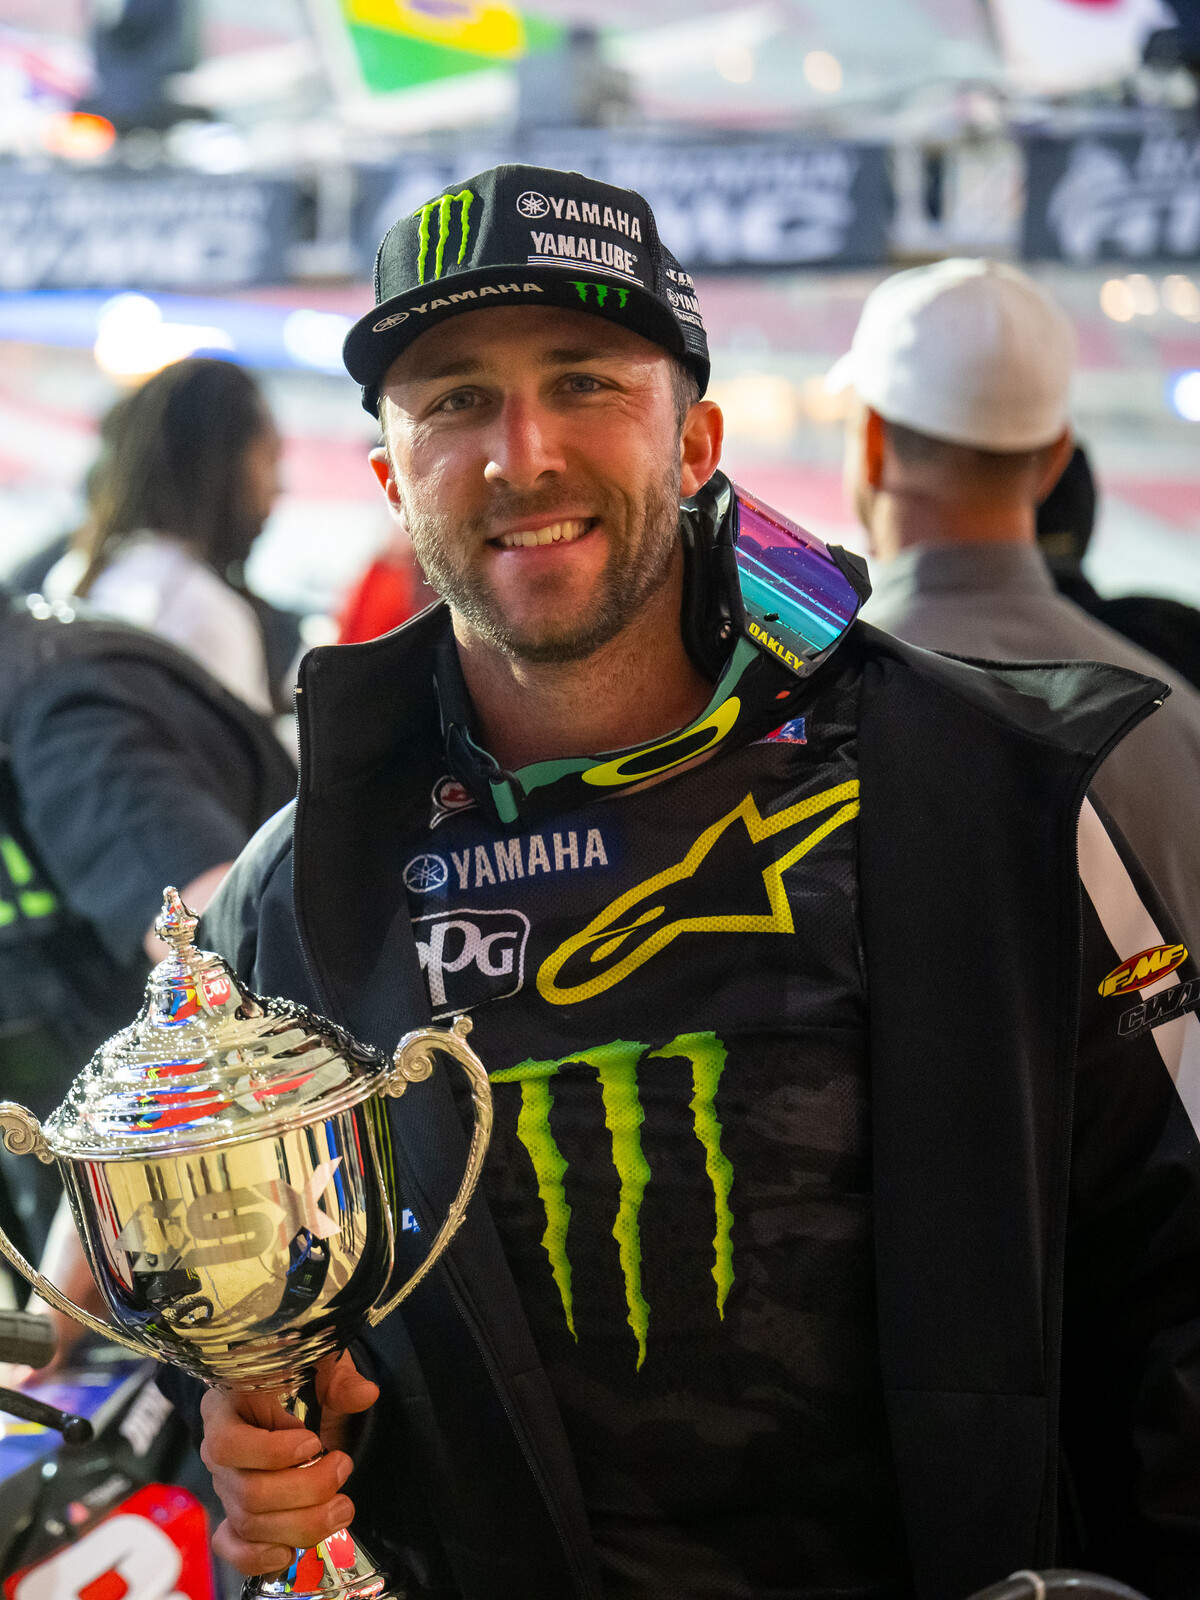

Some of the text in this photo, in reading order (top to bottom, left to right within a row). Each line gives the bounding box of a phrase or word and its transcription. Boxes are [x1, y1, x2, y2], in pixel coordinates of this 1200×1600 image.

[549, 197, 642, 243] YAMAHA
[530, 231, 635, 275] YAMALUBE
[410, 283, 544, 314] YAMAHA
[748, 622, 804, 671] OAKLEY
[450, 828, 609, 890] YAMAHA
[1102, 943, 1184, 998] FMF
